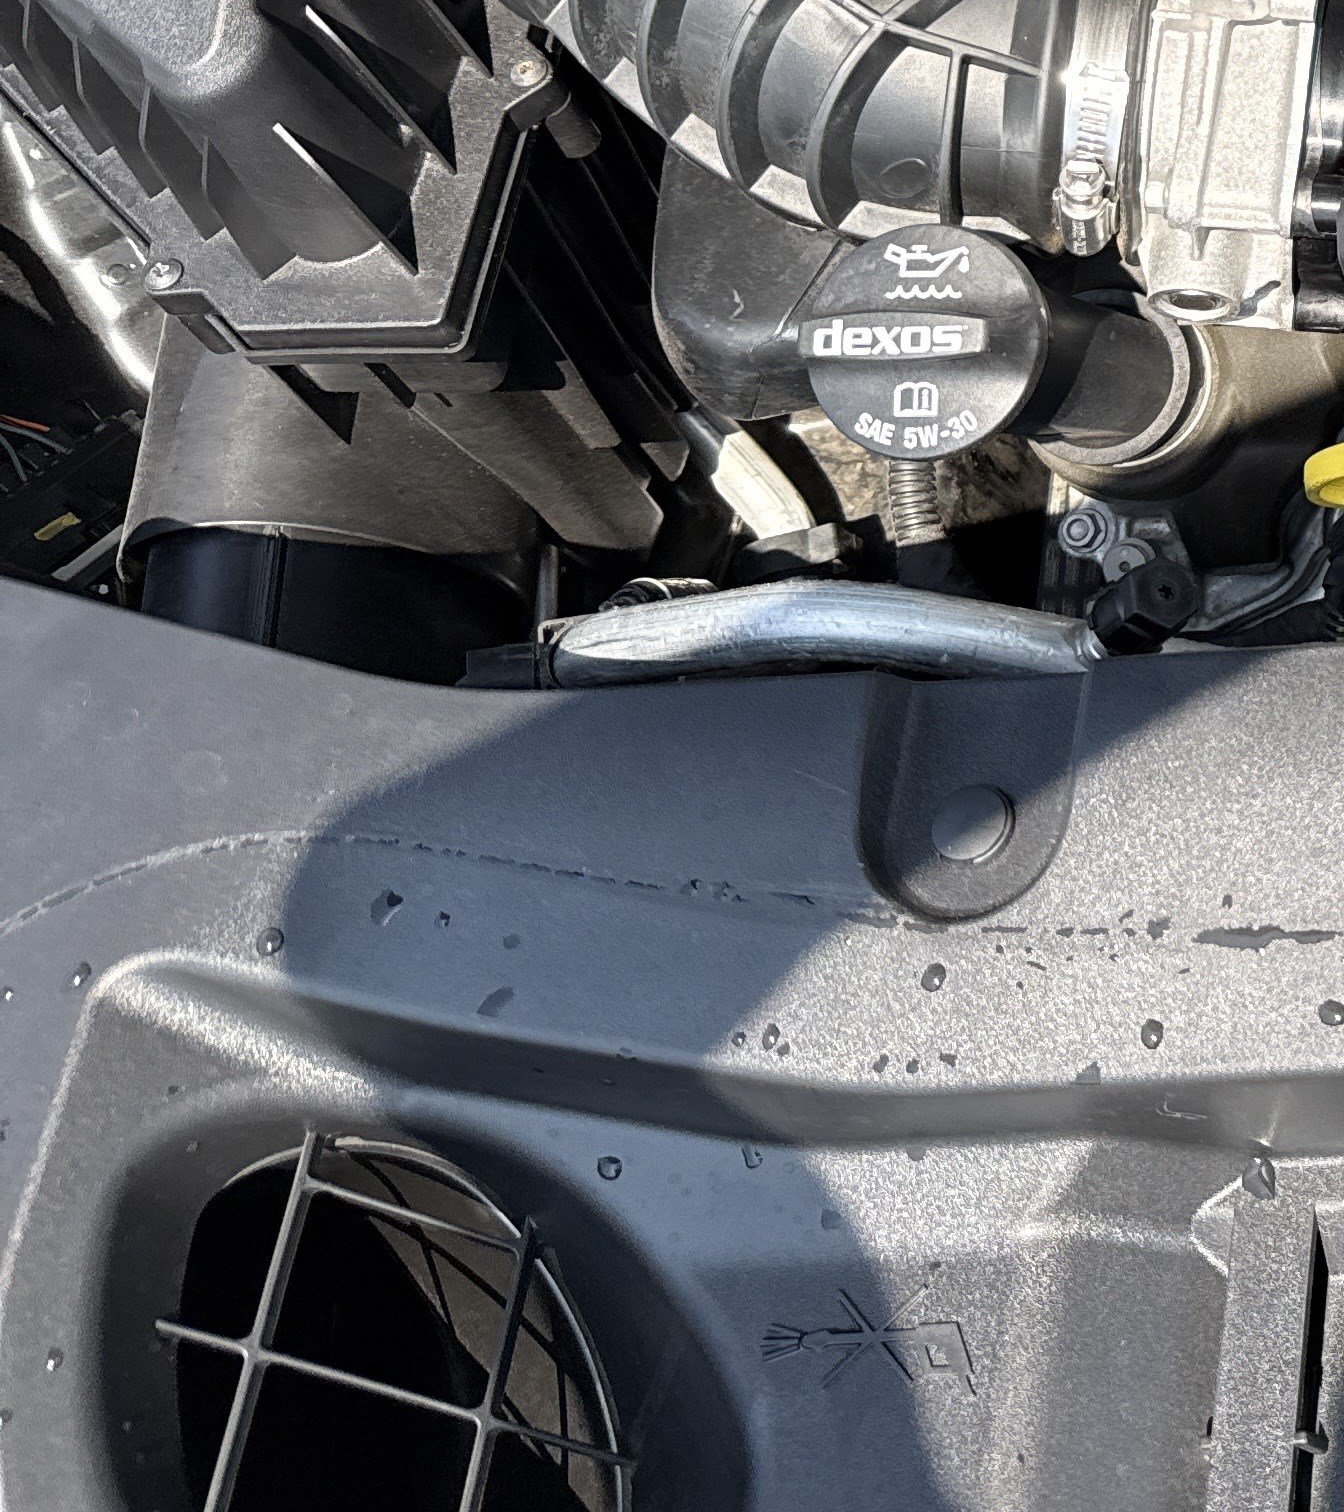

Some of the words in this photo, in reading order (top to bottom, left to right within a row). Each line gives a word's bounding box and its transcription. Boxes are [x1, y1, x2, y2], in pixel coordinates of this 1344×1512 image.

[812, 320, 964, 356] dexos
[854, 412, 894, 446] SAE
[902, 410, 978, 451] 5W-30
